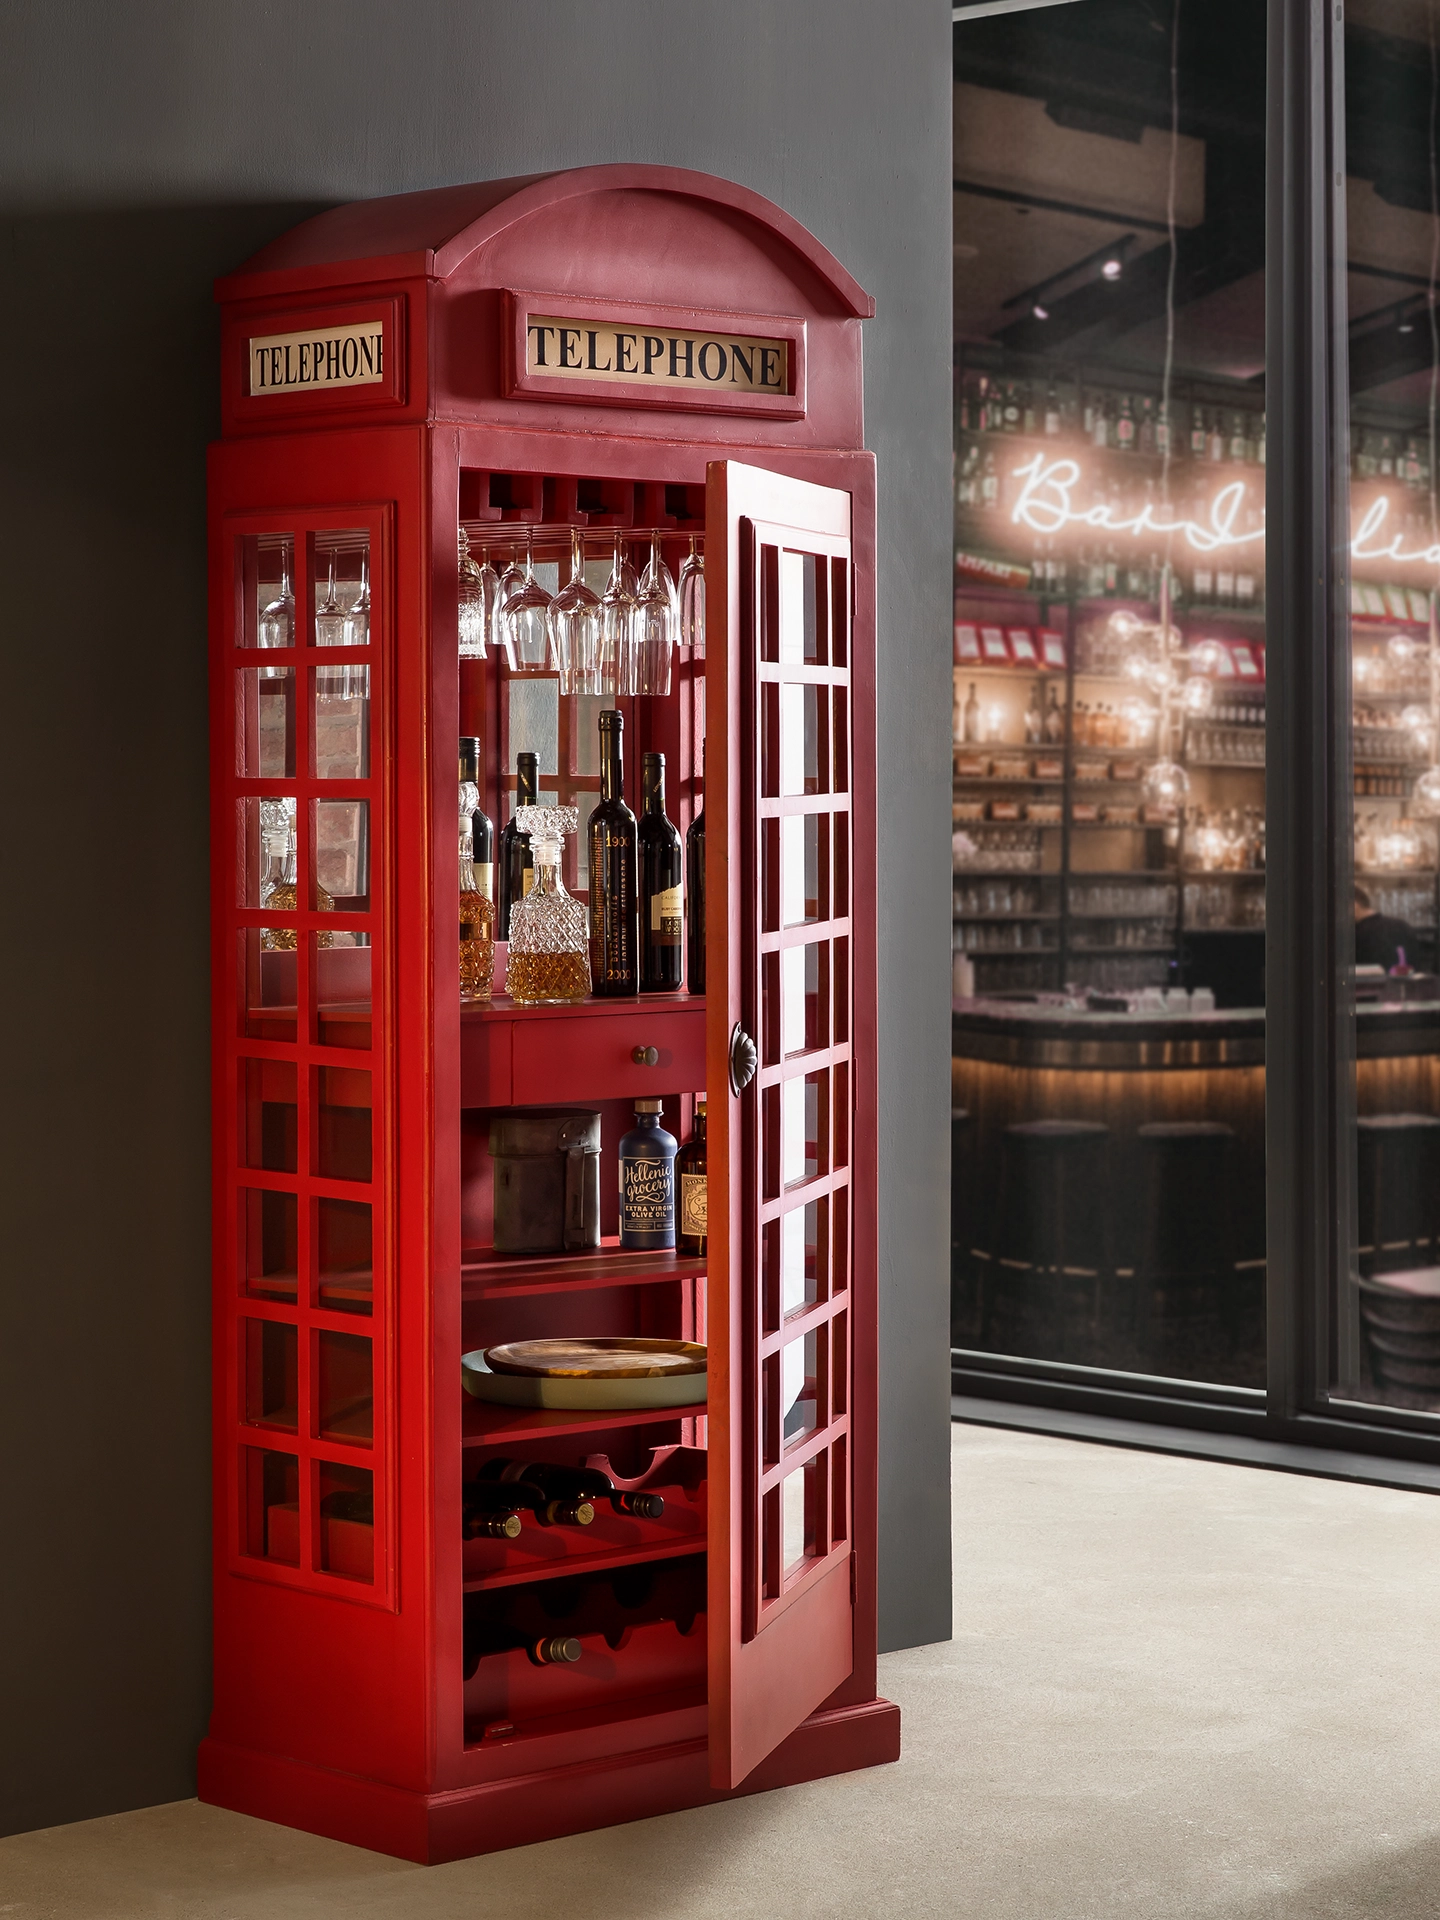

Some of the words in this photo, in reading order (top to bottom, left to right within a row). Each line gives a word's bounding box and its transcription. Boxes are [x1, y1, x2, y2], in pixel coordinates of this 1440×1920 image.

[528, 325, 782, 387] TELEPHONE
[605, 836, 630, 848] 1900
[606, 969, 631, 980] 2000
[625, 1163, 671, 1185] Hellenic
[627, 1178, 671, 1202] grocery
